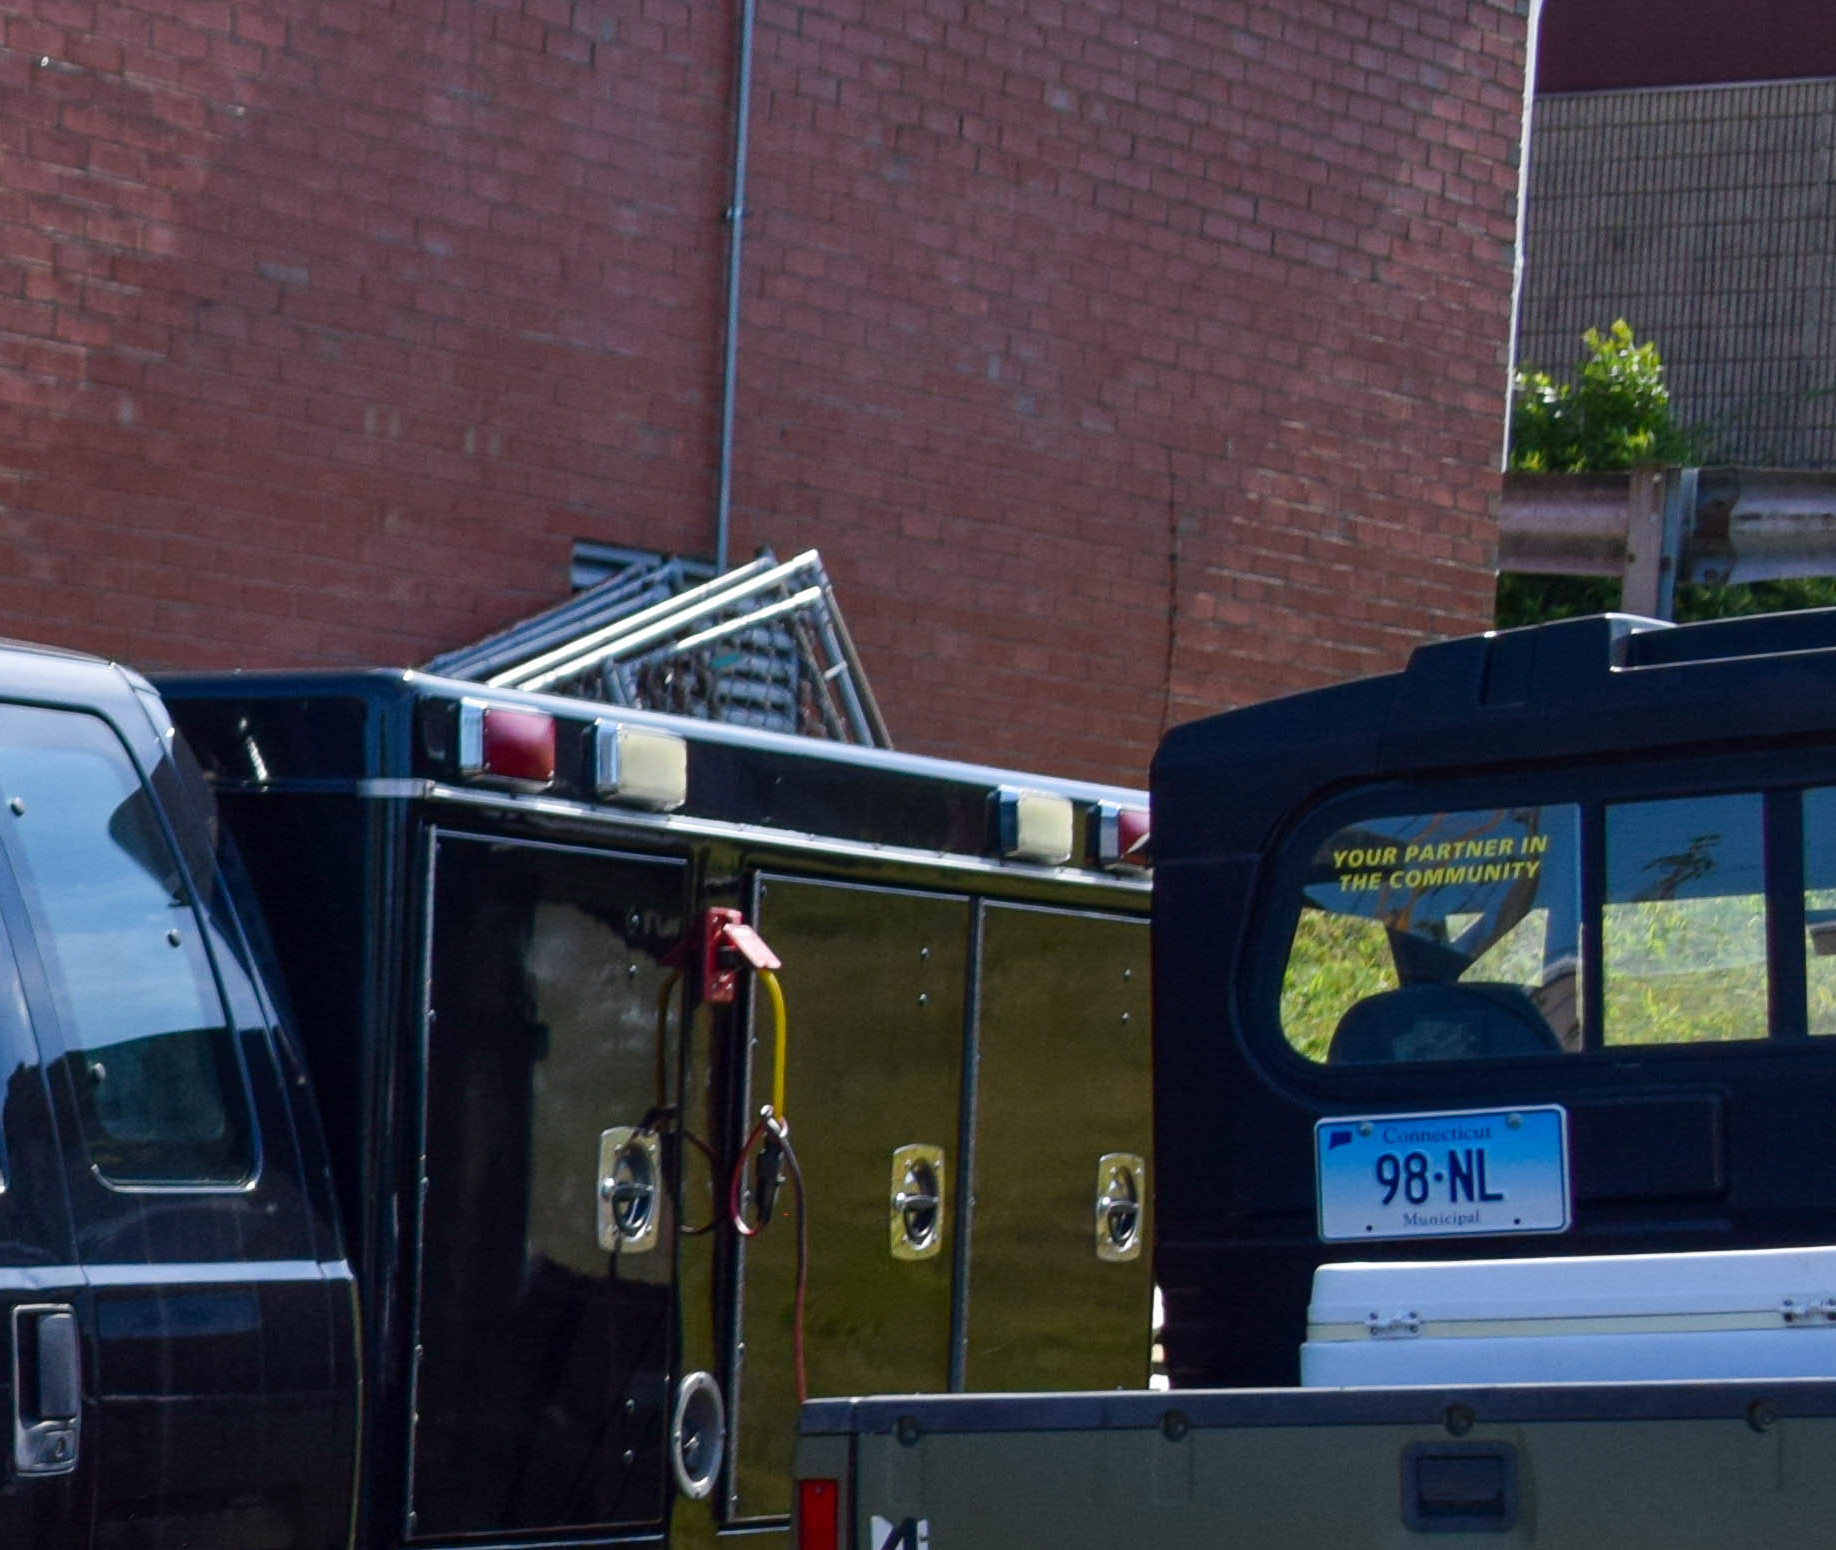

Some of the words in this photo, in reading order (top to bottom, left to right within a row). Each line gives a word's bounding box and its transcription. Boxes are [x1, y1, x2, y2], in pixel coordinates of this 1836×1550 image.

[1332, 849, 1398, 869] YOUR
[1403, 836, 1514, 863] PARTNER
[1520, 834, 1548, 854] IN
[1339, 872, 1383, 892] THE
[1388, 860, 1540, 889] COMMUNITY
[1382, 1122, 1494, 1145] Connecticut
[1403, 1209, 1481, 1228] Municipal
